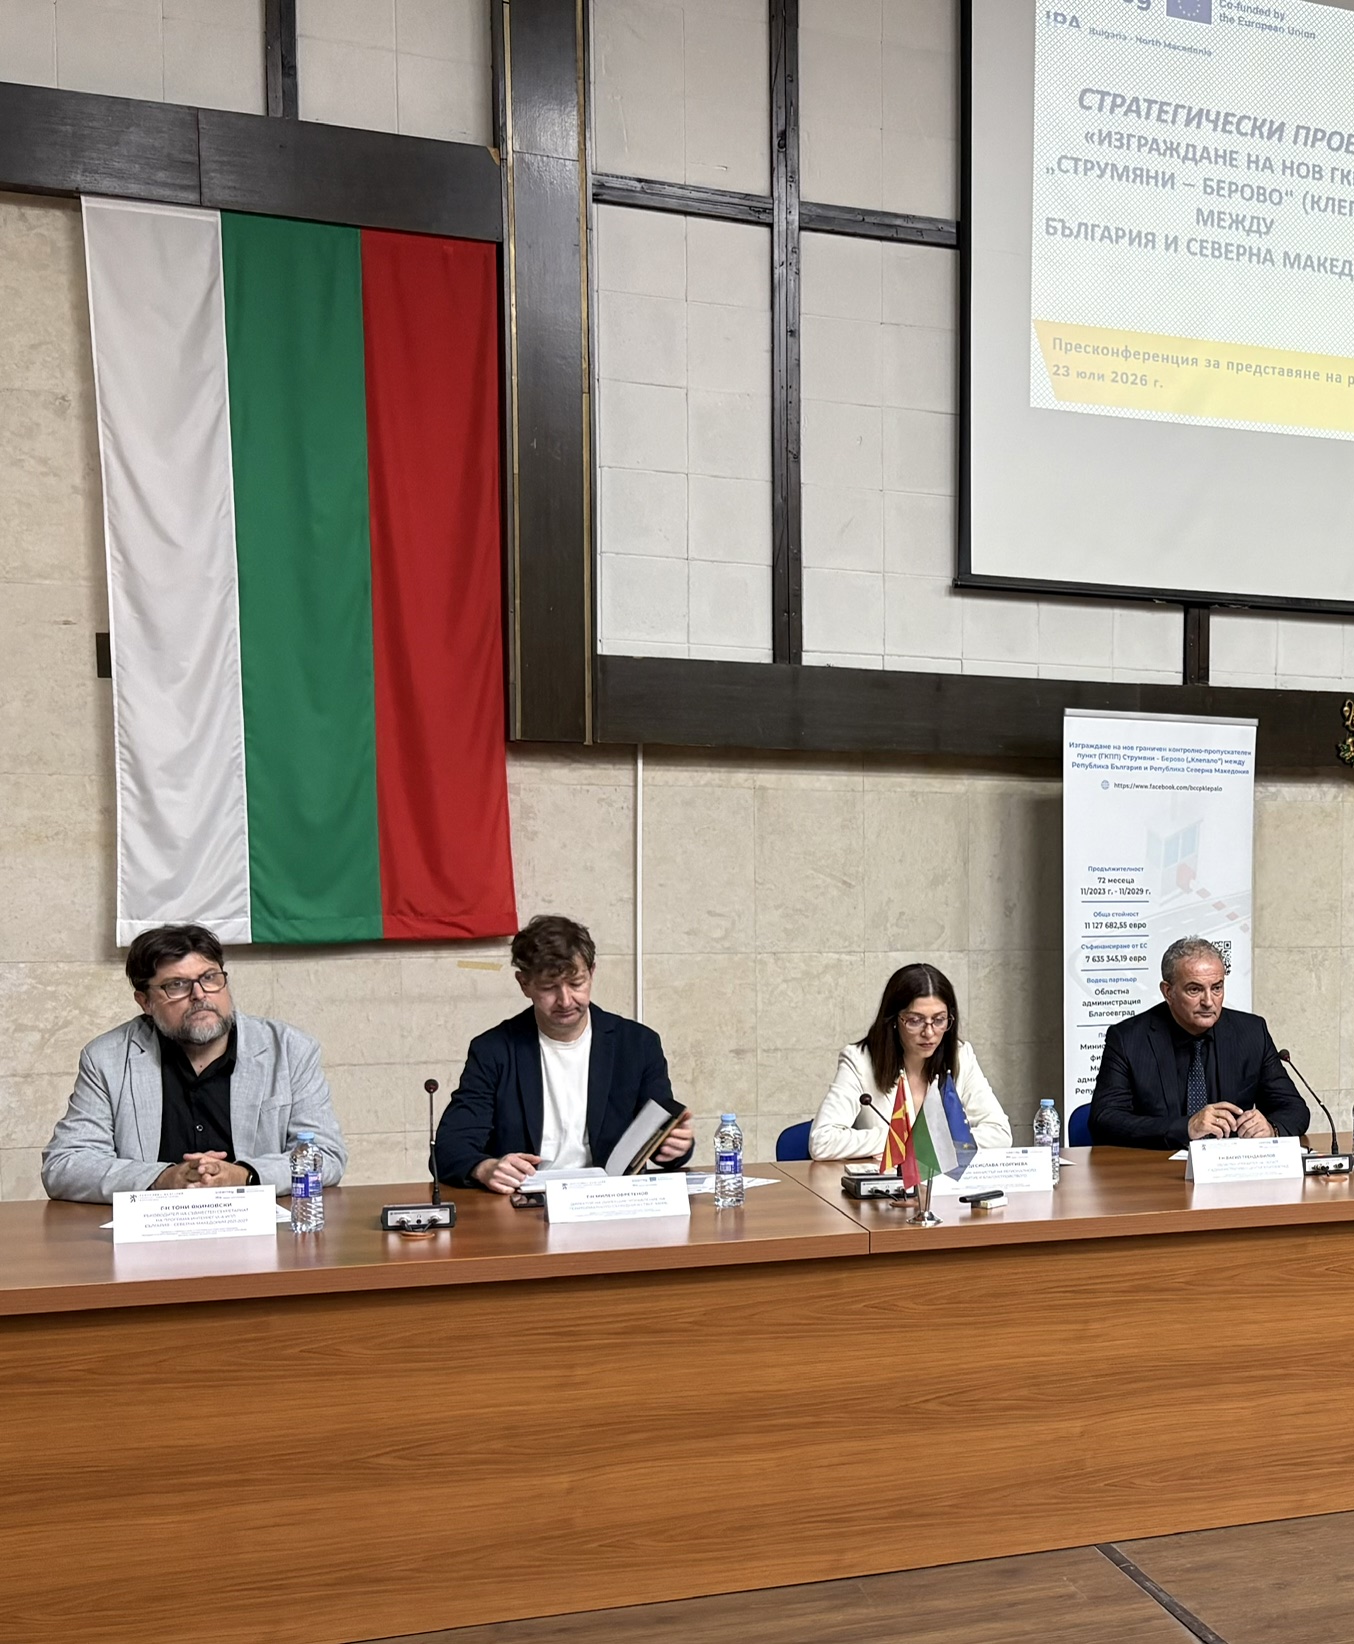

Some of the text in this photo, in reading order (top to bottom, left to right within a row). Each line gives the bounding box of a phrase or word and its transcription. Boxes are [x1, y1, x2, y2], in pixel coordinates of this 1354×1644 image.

[1275, 10, 1285, 22] by
[1219, 12, 1316, 40] the European Union
[1078, 88, 1285, 143] СТРАТЕГИЧЕСКИ
[1084, 129, 1239, 168] «ИЗГРАЖДАНЕ
[1246, 153, 1275, 175] НА
[1282, 159, 1324, 183] НОВ
[1045, 155, 1176, 190] „СТРУМЯНИ
[1195, 207, 1274, 238] МЕЖДУ
[1045, 217, 1156, 251] БЪЛГАРИЯ
[1164, 234, 1178, 253] И
[1186, 237, 1275, 267] СЕВЕРНА
[1052, 337, 1198, 368] Пресконференция
[1204, 356, 1221, 371] за
[1226, 360, 1321, 382] представяне
[1325, 371, 1342, 384] на
[1052, 364, 1163, 389] 23 юли 2026 г.
[1069, 742, 1112, 751] Изграждане
[1168, 747, 1252, 756] контролно-пропускателен
[1071, 762, 1109, 770] Република
[1110, 763, 1142, 772] България
[1149, 765, 1185, 773] Република
[1107, 877, 1135, 885] месеца
[1080, 888, 1106, 896] 11/2023
[1118, 888, 1144, 896] 11/2029
[1091, 922, 1104, 930] 127
[1104, 921, 1128, 931] 682,55
[1129, 922, 1147, 930] евро
[1091, 955, 1105, 963] 635
[1105, 955, 1128, 964] 345,19
[1129, 955, 1147, 963] евро
[1094, 987, 1130, 996] Областна
[1082, 998, 1141, 1008] администрация
[1088, 1009, 1136, 1018] Благоевград
